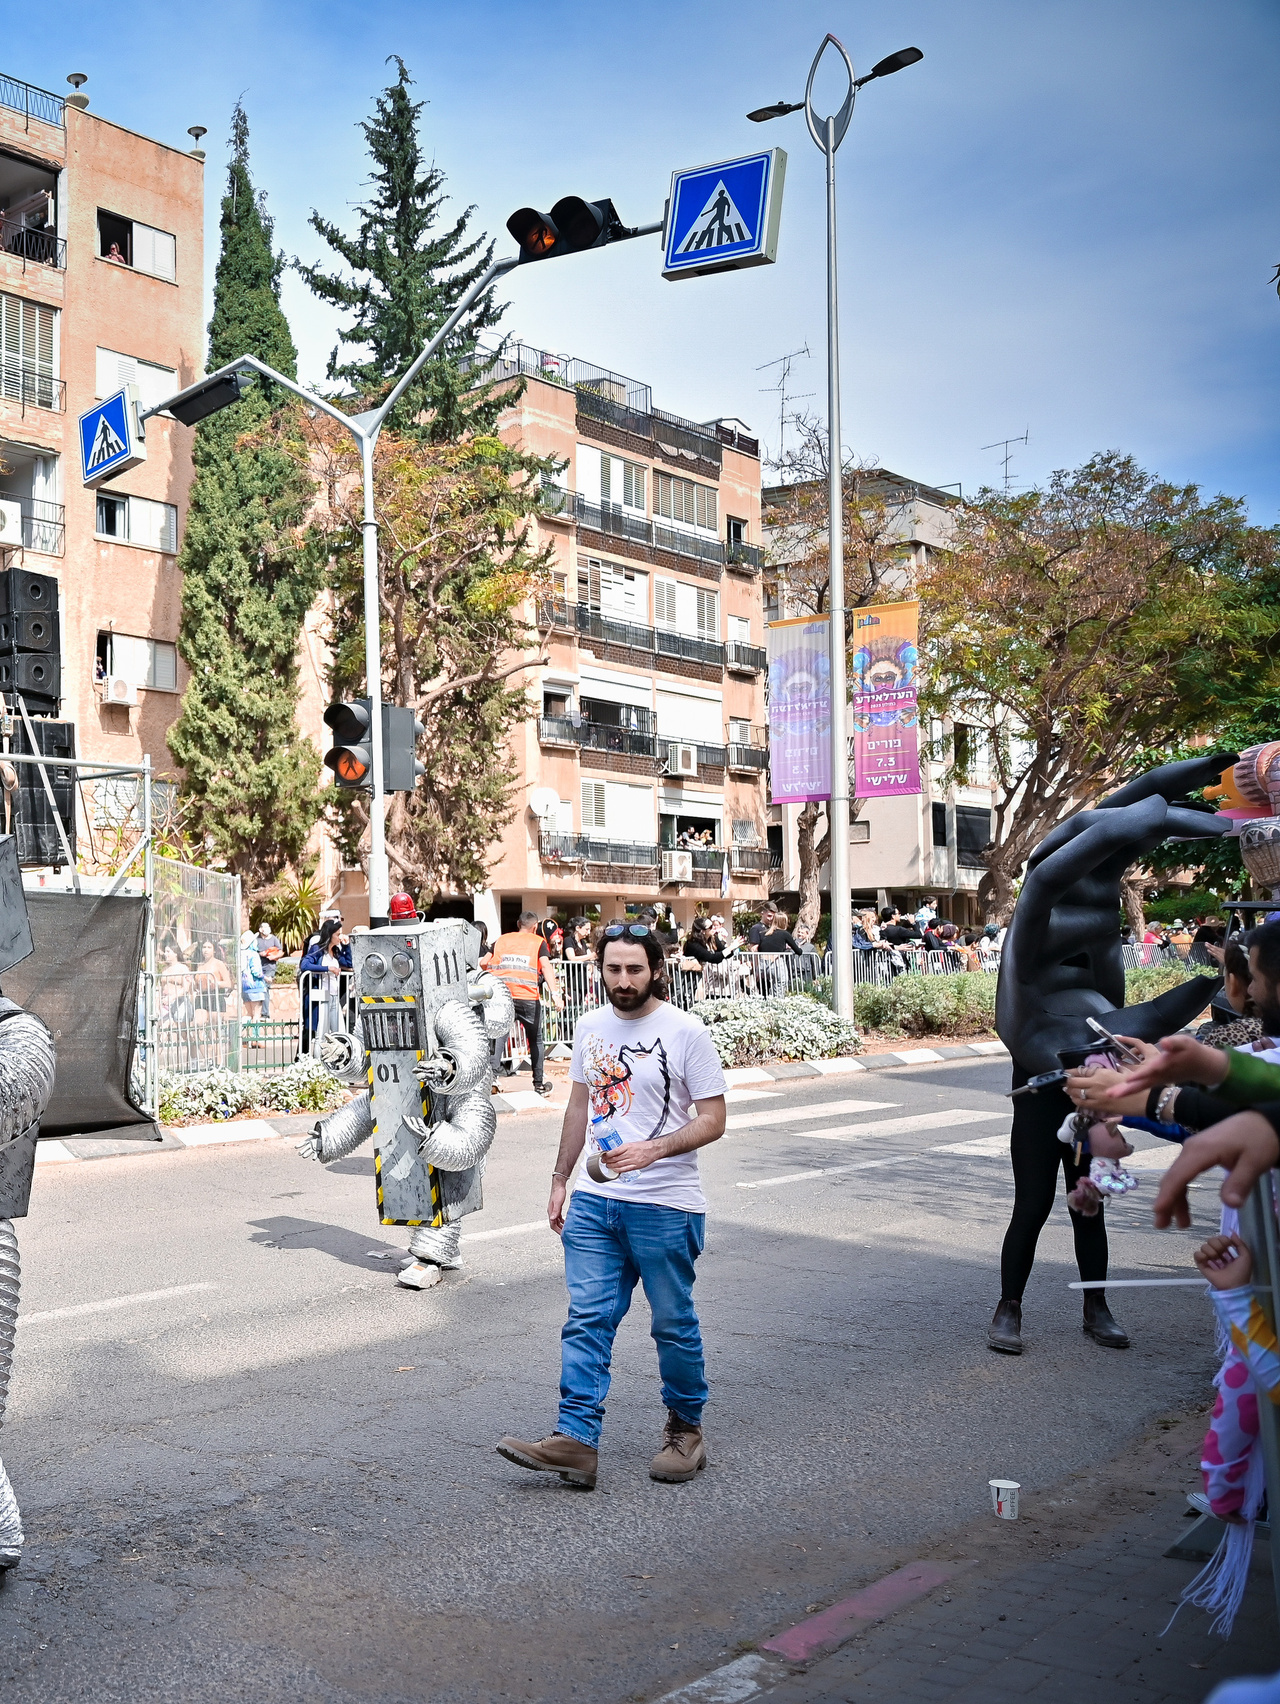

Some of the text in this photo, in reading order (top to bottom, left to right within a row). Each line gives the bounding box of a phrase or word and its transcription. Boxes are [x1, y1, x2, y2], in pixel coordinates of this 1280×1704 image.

[855, 690, 914, 704] העדלאידע
[866, 737, 902, 750] פורים
[876, 757, 896, 768] 7.3
[865, 773, 908, 786] שלישי
[376, 1063, 400, 1084] 01
